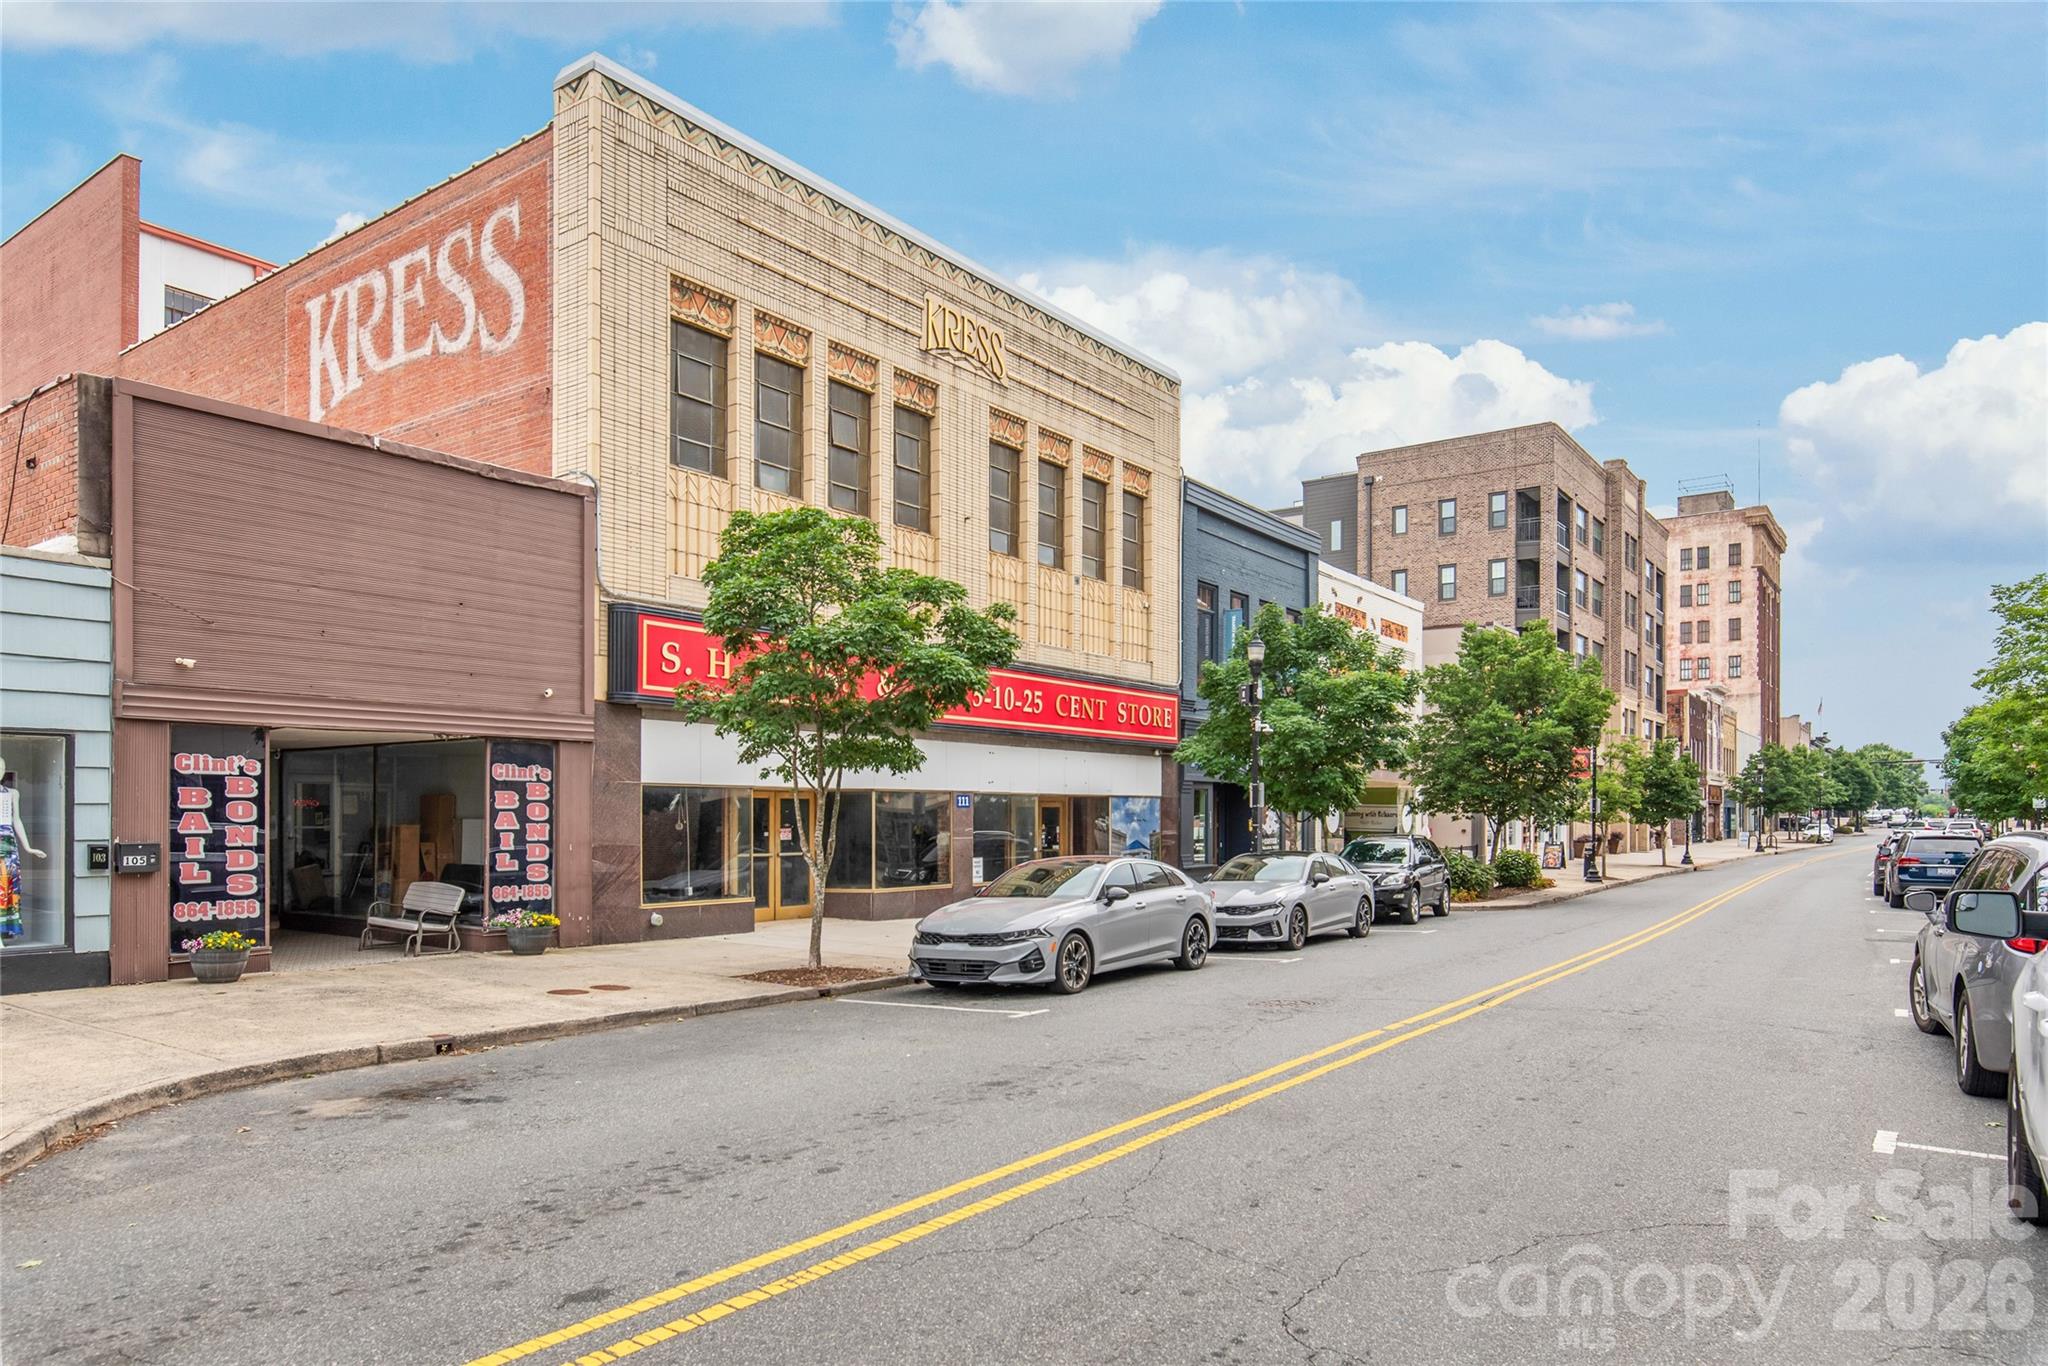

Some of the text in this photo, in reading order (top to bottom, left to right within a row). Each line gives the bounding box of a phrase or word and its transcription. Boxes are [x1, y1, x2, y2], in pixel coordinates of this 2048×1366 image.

[305, 200, 525, 423] KRESS
[925, 298, 1006, 380] KRESS
[661, 641, 693, 676] S.
[973, 686, 1043, 713] 5-10-25
[1056, 693, 1107, 721] CENT
[1117, 701, 1172, 729] STORE
[174, 753, 261, 776] Clint's
[492, 763, 551, 781] Clint's
[957, 796, 969, 806] 111
[177, 787, 212, 884] BAIL
[225, 776, 258, 895] BONDS
[494, 790, 519, 871] BAIL
[526, 783, 549, 881] BONDS
[92, 852, 106, 862] 103
[124, 856, 147, 865] 105
[173, 899, 260, 922] 864-1856
[492, 884, 552, 902] 864-1856
